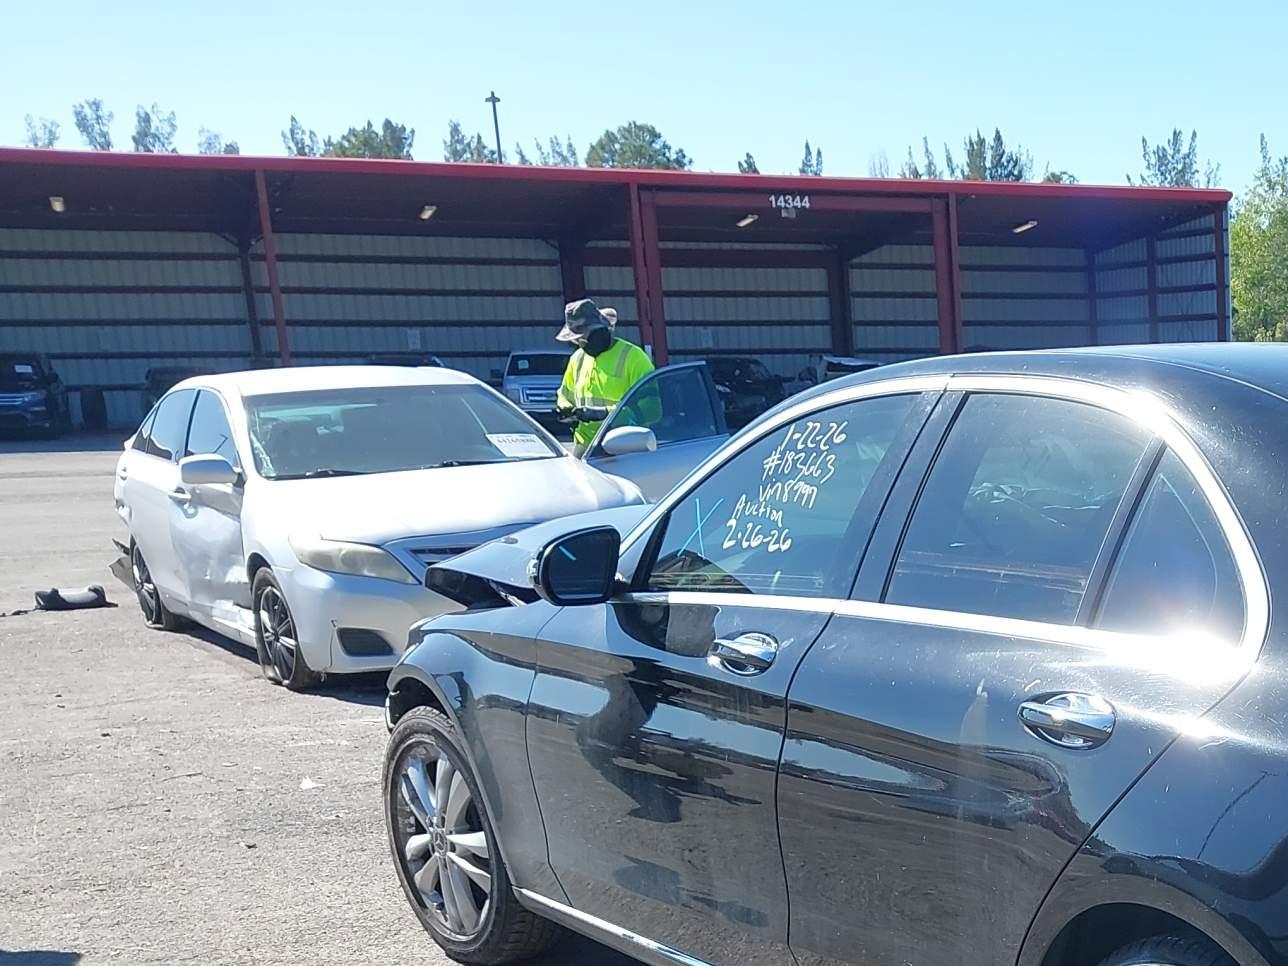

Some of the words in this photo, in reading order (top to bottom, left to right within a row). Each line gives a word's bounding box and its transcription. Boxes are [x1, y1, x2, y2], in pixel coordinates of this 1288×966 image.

[769, 195, 810, 209] 14344
[781, 421, 848, 451] 1-22-26
[762, 446, 836, 484] #183663
[732, 493, 783, 528] Auction
